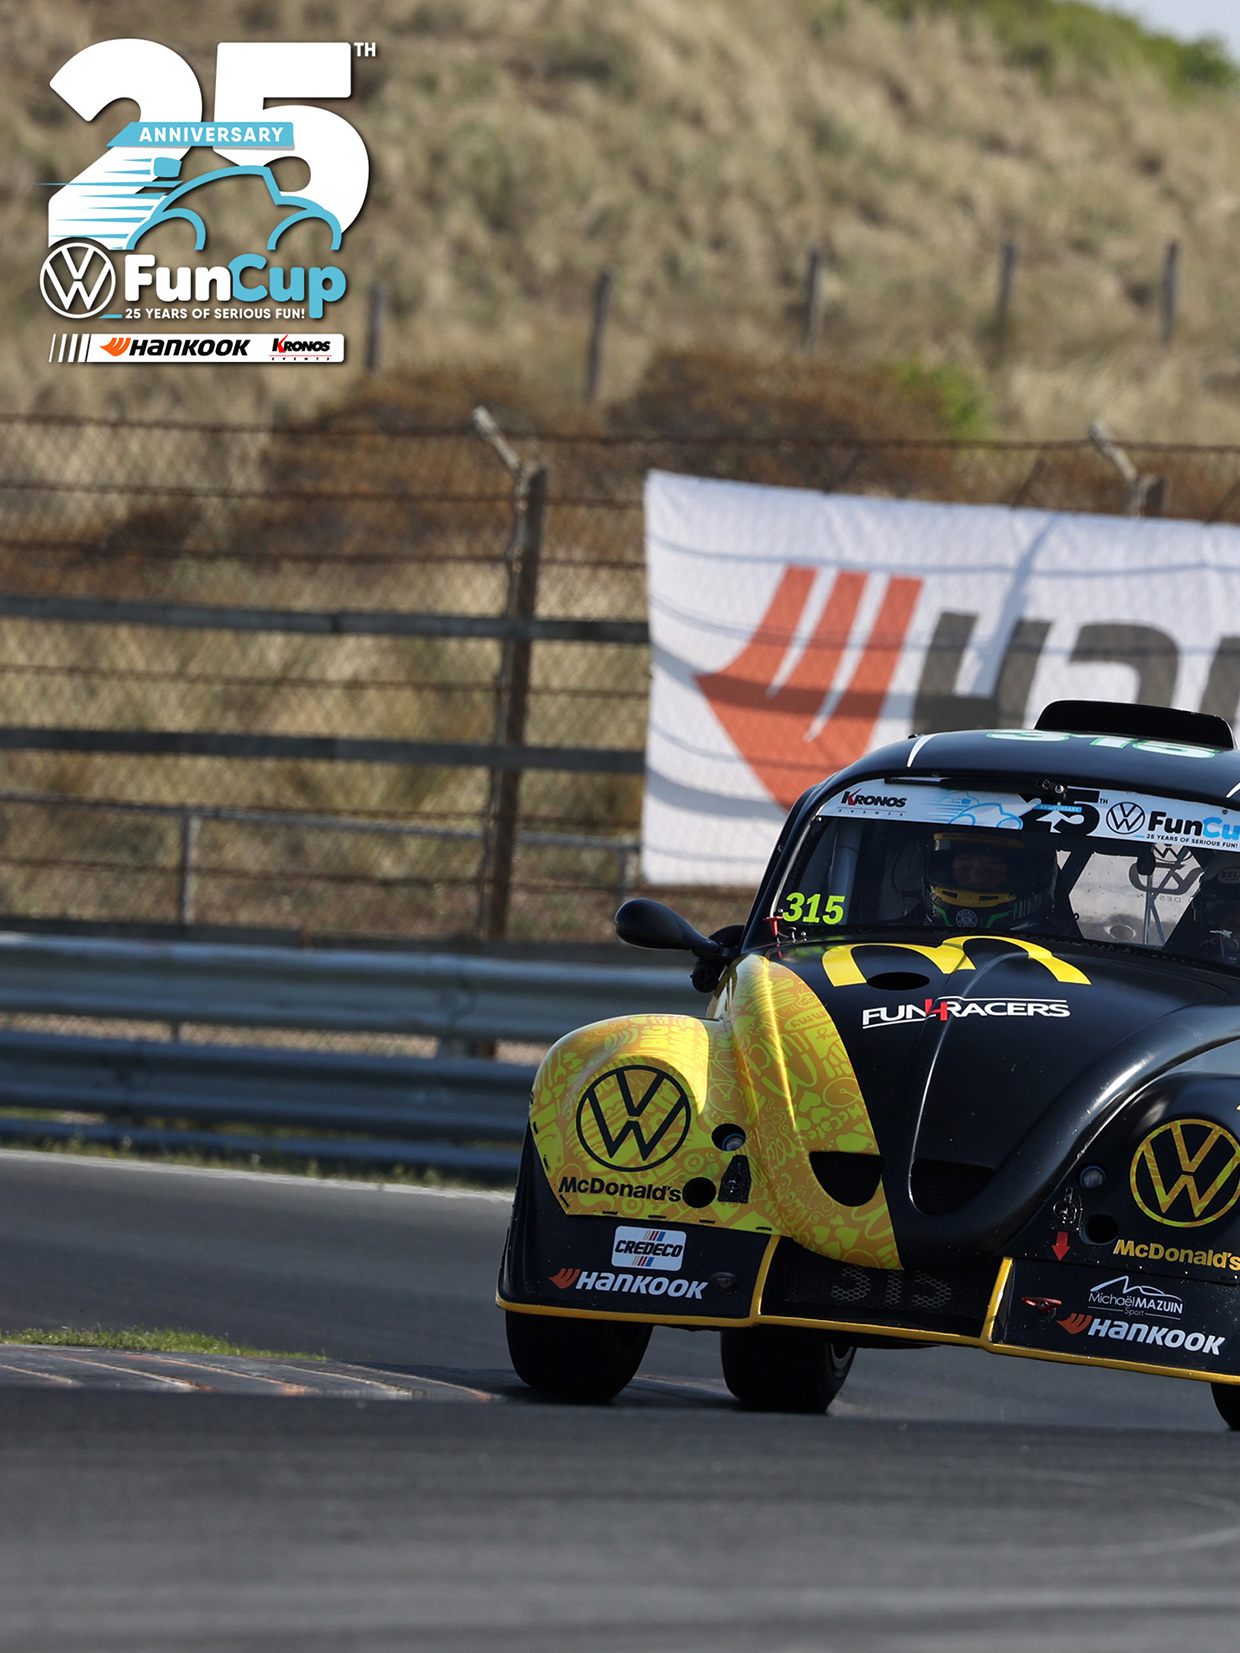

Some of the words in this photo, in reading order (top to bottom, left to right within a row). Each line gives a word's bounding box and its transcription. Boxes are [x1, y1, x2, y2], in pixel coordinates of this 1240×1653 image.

[840, 788, 907, 808] KRONOS
[1191, 838, 1221, 847] SERIOUS
[1222, 841, 1239, 849] FUN!
[782, 892, 845, 925] 315
[558, 1176, 684, 1203] McDonald's
[614, 1238, 684, 1258] CREDECO
[1124, 1308, 1145, 1318] Sport
